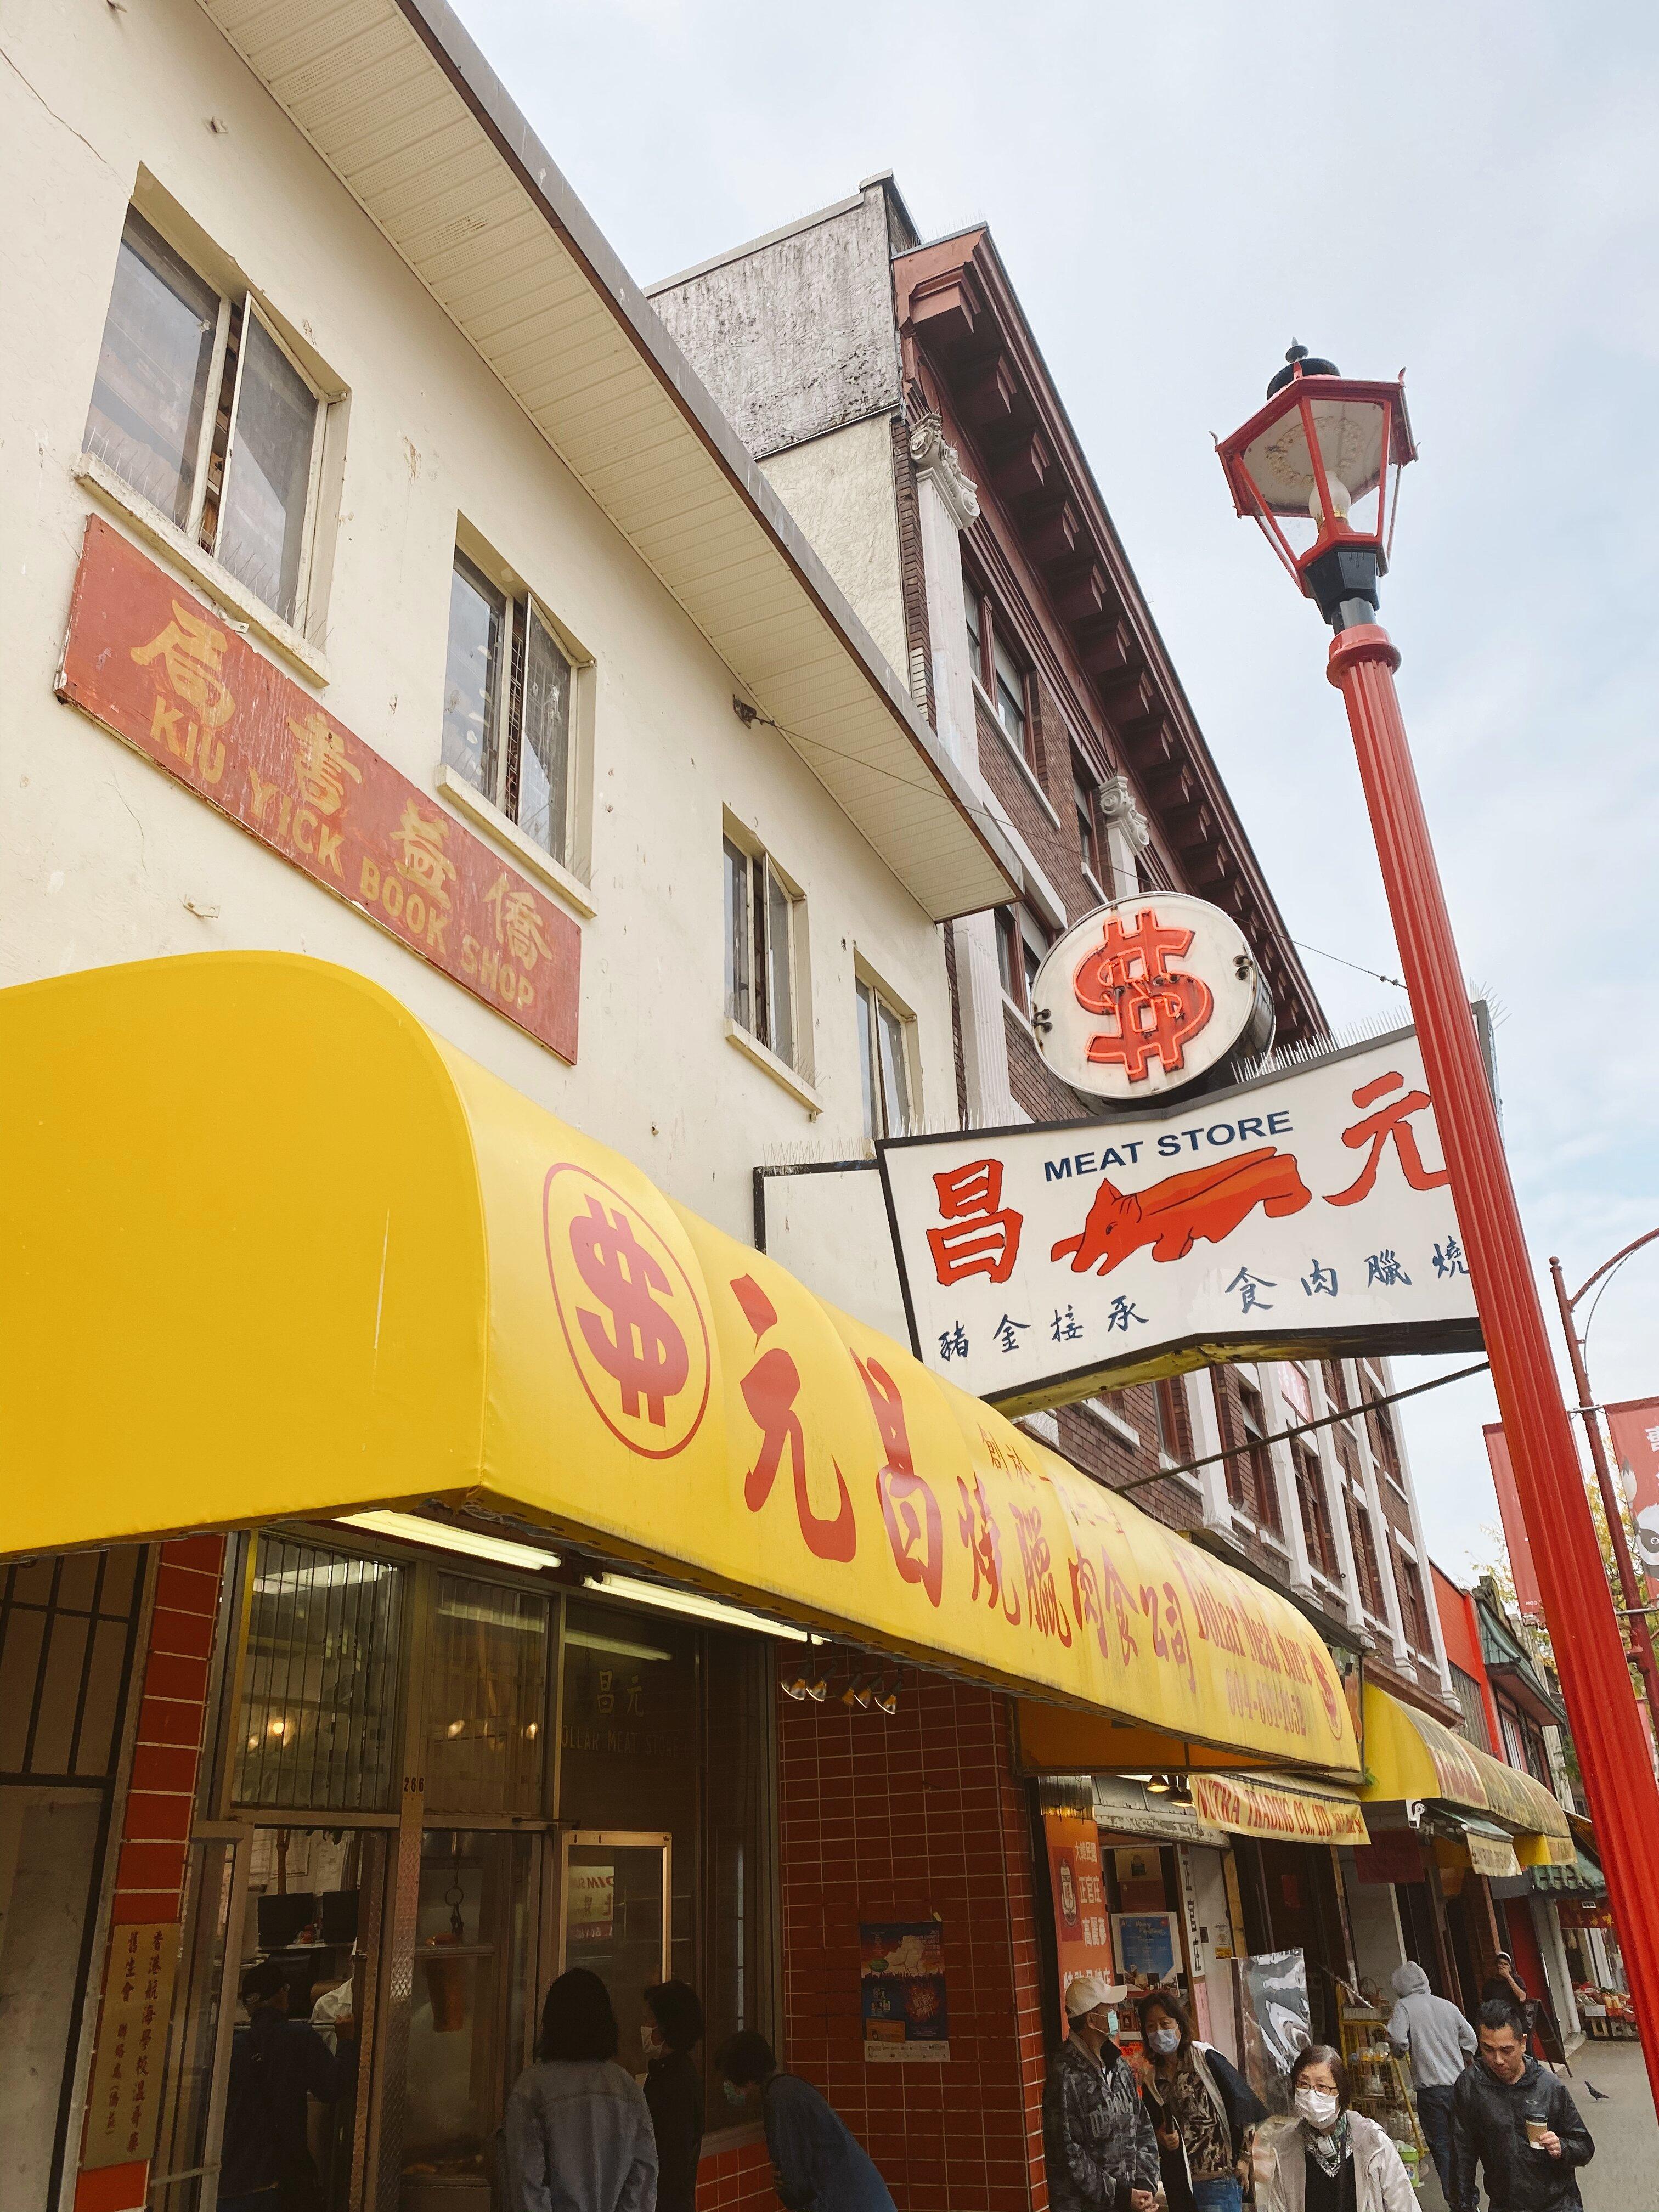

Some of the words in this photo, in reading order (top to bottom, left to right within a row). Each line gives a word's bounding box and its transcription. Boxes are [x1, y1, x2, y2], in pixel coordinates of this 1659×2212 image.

[149, 696, 227, 785] KIU
[248, 765, 345, 880] YICK
[358, 857, 449, 953] BOOK
[460, 934, 534, 1011] SHOP
[1044, 1140, 1145, 1182] MEAT
[1157, 1109, 1294, 1158] STORE
[1195, 1776, 1240, 1825] NUTRA
[1244, 1790, 1294, 1833] TRADING
